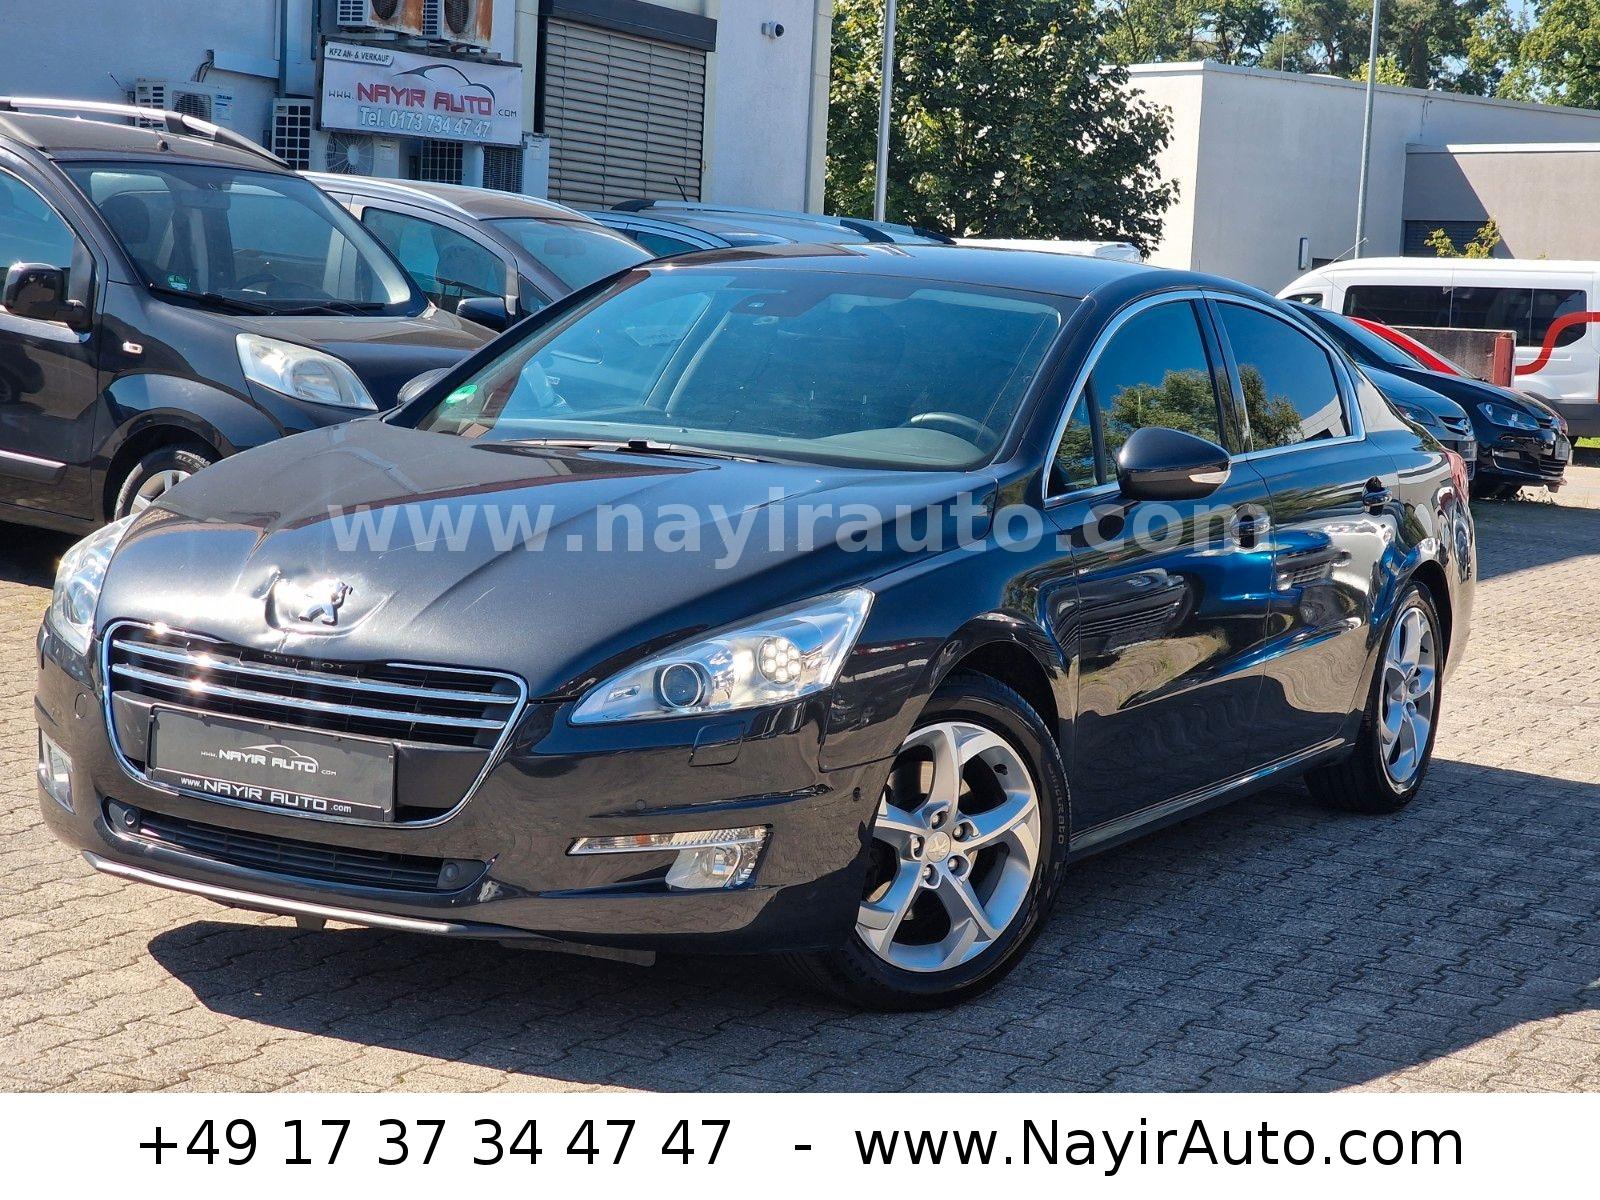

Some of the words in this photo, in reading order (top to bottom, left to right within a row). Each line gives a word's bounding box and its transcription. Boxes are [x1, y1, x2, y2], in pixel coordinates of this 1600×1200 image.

[329, 47, 342, 57] KFZ
[361, 51, 390, 63] VERKAUF
[357, 82, 425, 108] NAYIR
[433, 91, 492, 116] AUTO
[360, 106, 384, 128] Tel.
[389, 109, 423, 131] 0173
[427, 114, 451, 134] 734
[454, 117, 472, 136] 47
[473, 119, 491, 138] 47
[219, 749, 266, 766] NAYIR
[272, 757, 316, 773] AUTO
[181, 777, 202, 788] www.
[203, 779, 263, 800] NAYIR
[270, 791, 328, 811] AUTO
[330, 803, 352, 813] .com
